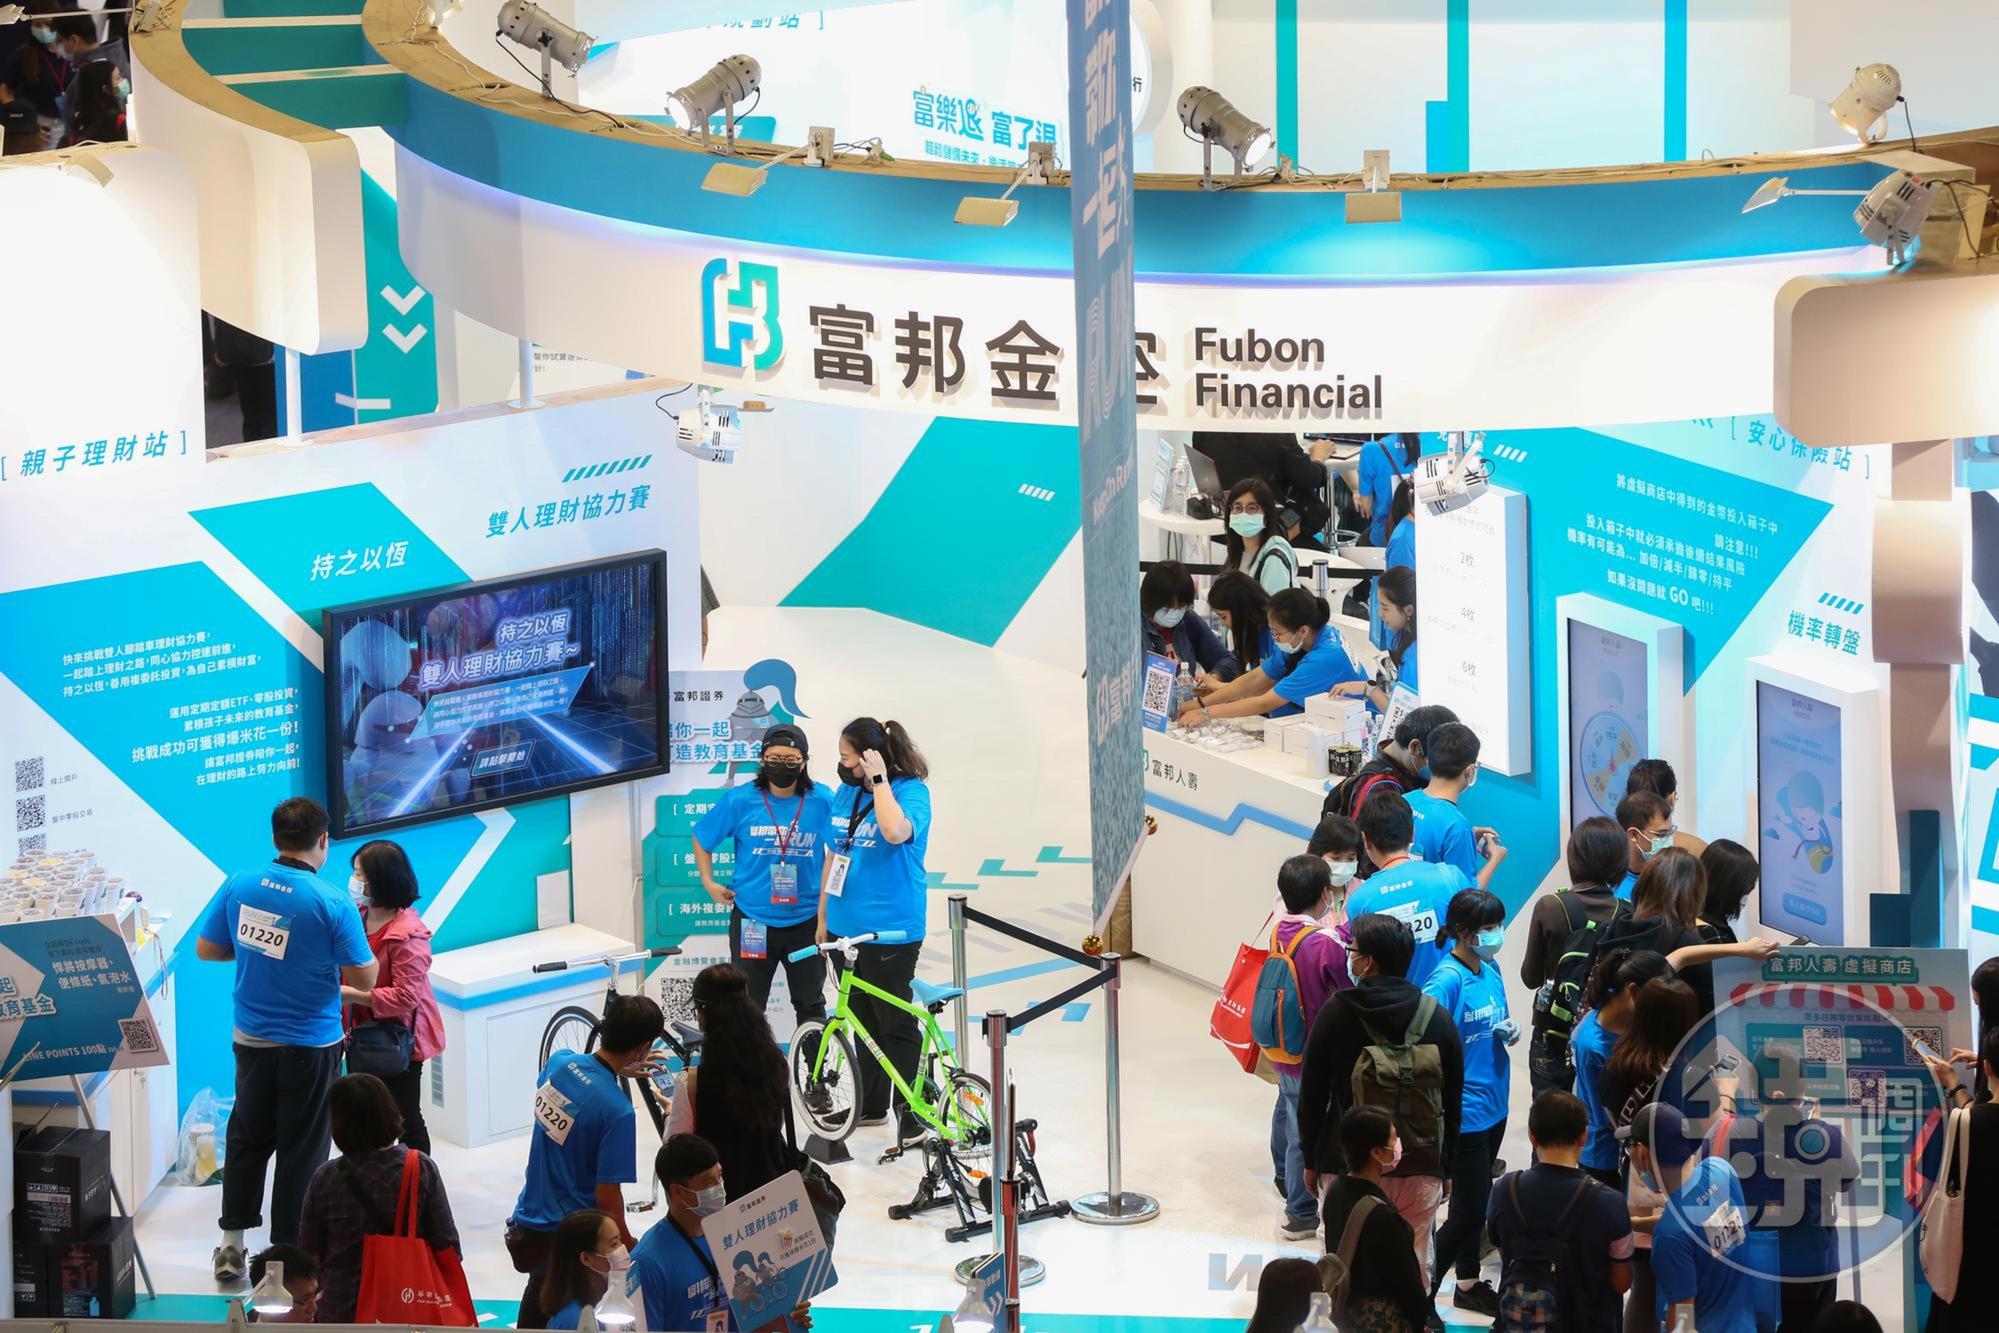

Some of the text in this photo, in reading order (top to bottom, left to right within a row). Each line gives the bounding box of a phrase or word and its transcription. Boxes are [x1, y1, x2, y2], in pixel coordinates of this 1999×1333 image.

[1193, 327, 1326, 364] Fubon
[1193, 373, 1383, 410] Financial
[485, 483, 652, 539] 雙人理財協力賽
[310, 540, 408, 582] 持之以恆
[1669, 585, 1690, 606] GO
[499, 612, 568, 642] 持之以恆
[1787, 608, 1862, 656] 機率轉盤
[673, 690, 724, 702] 富邦證券
[668, 721, 730, 739] 你一起
[1152, 758, 1200, 792] 富邦人壽
[240, 923, 284, 947] 01220
[1769, 957, 1912, 975] 富邦人壽 虛擬商店
[45, 1047, 80, 1060] POINTS
[535, 1096, 568, 1131] 01220
[722, 1198, 799, 1250] 雙人理財協力賽
